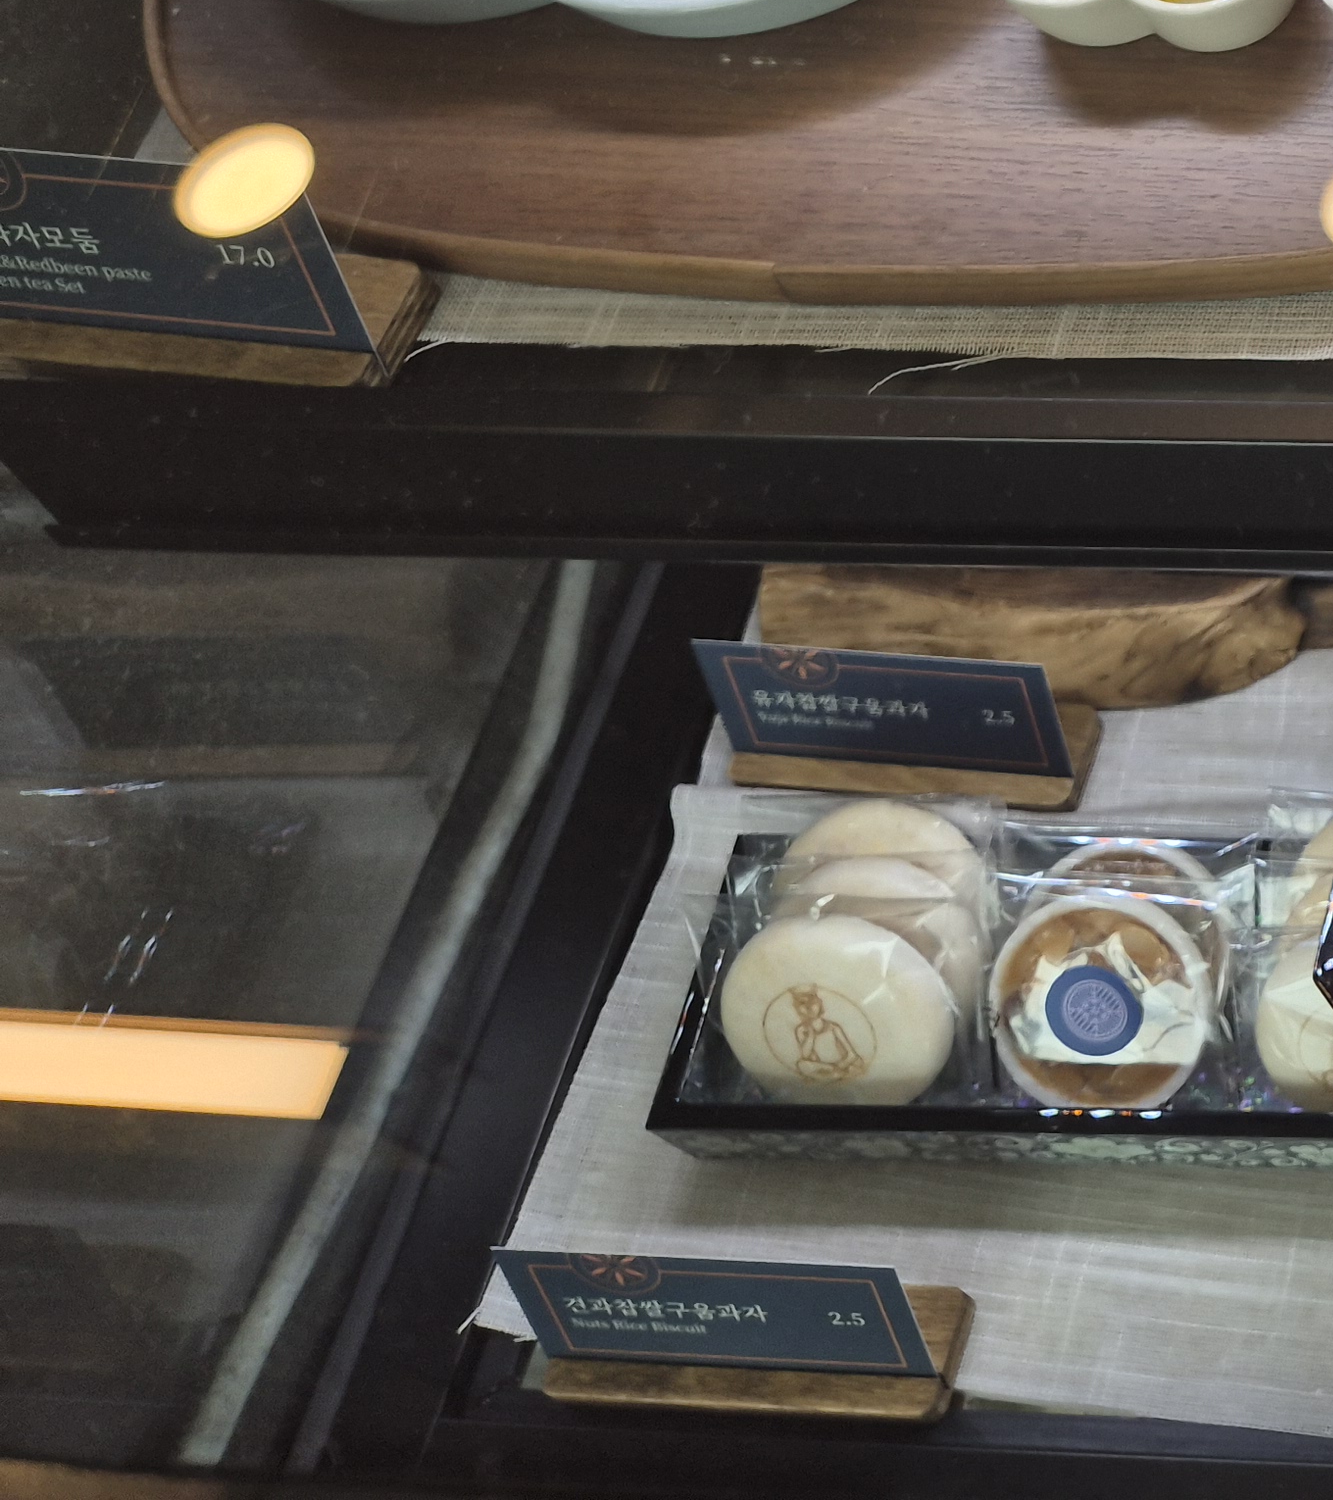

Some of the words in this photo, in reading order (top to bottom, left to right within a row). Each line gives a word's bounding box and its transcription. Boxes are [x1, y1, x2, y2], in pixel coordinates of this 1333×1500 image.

[215, 243, 275, 269] 17.0
[101, 266, 152, 282] paste
[54, 278, 87, 294] Set
[827, 1311, 866, 1327] 2.5
